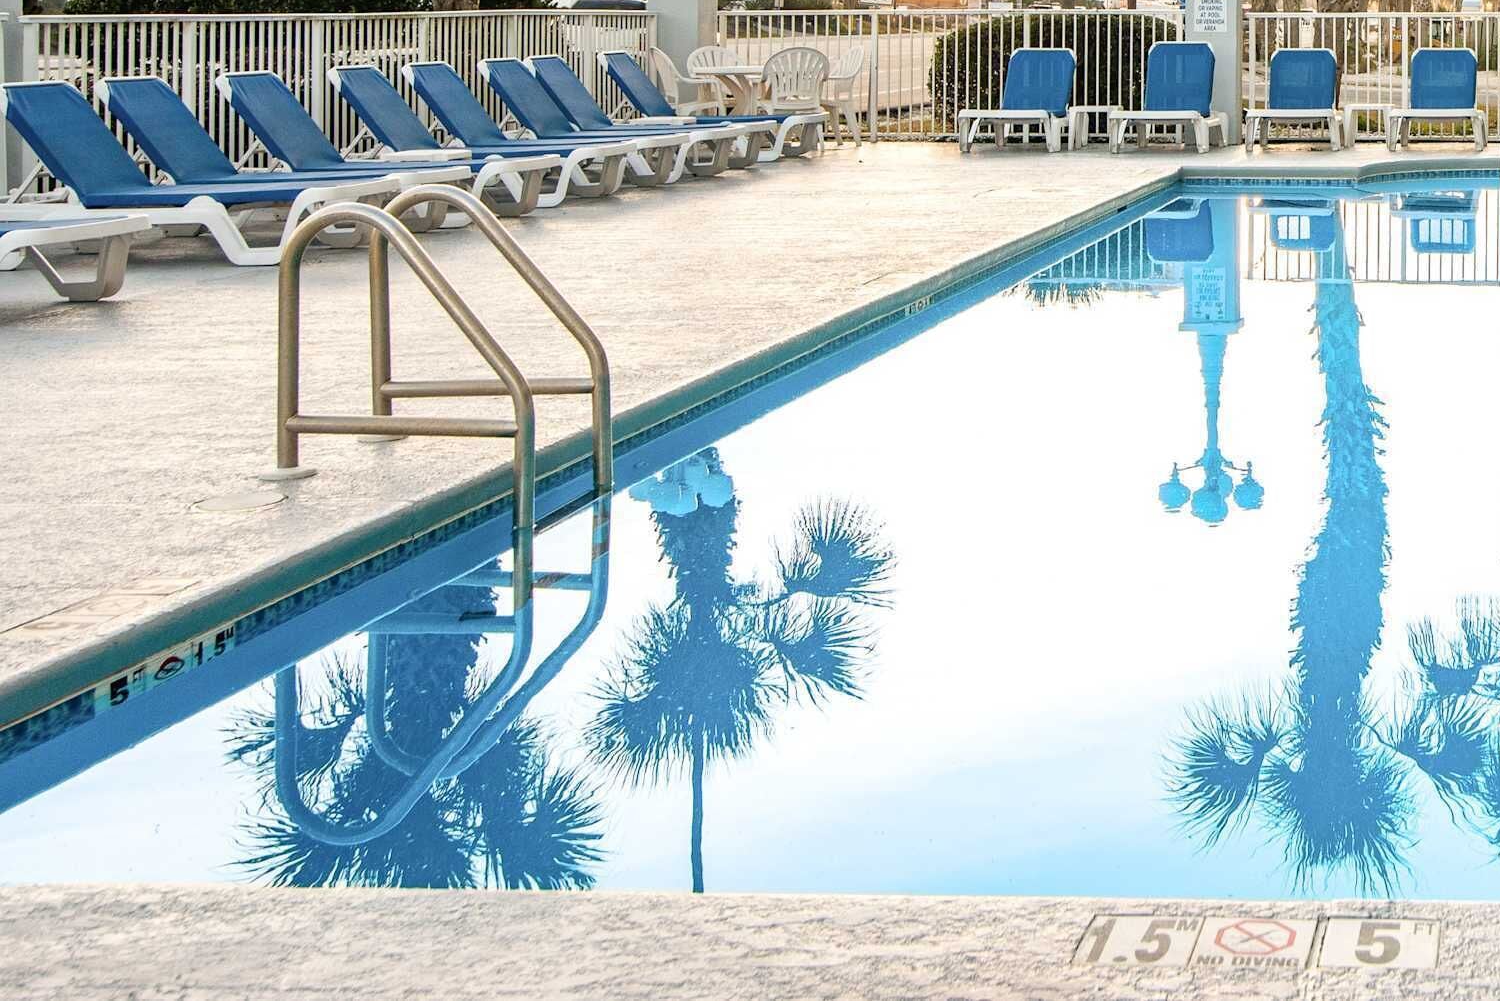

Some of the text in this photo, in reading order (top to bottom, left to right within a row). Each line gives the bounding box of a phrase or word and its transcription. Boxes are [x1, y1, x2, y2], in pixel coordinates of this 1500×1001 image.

[110, 675, 130, 707] 5
[1355, 921, 1401, 965] 5
[1196, 955, 1300, 968] NO DIVING
